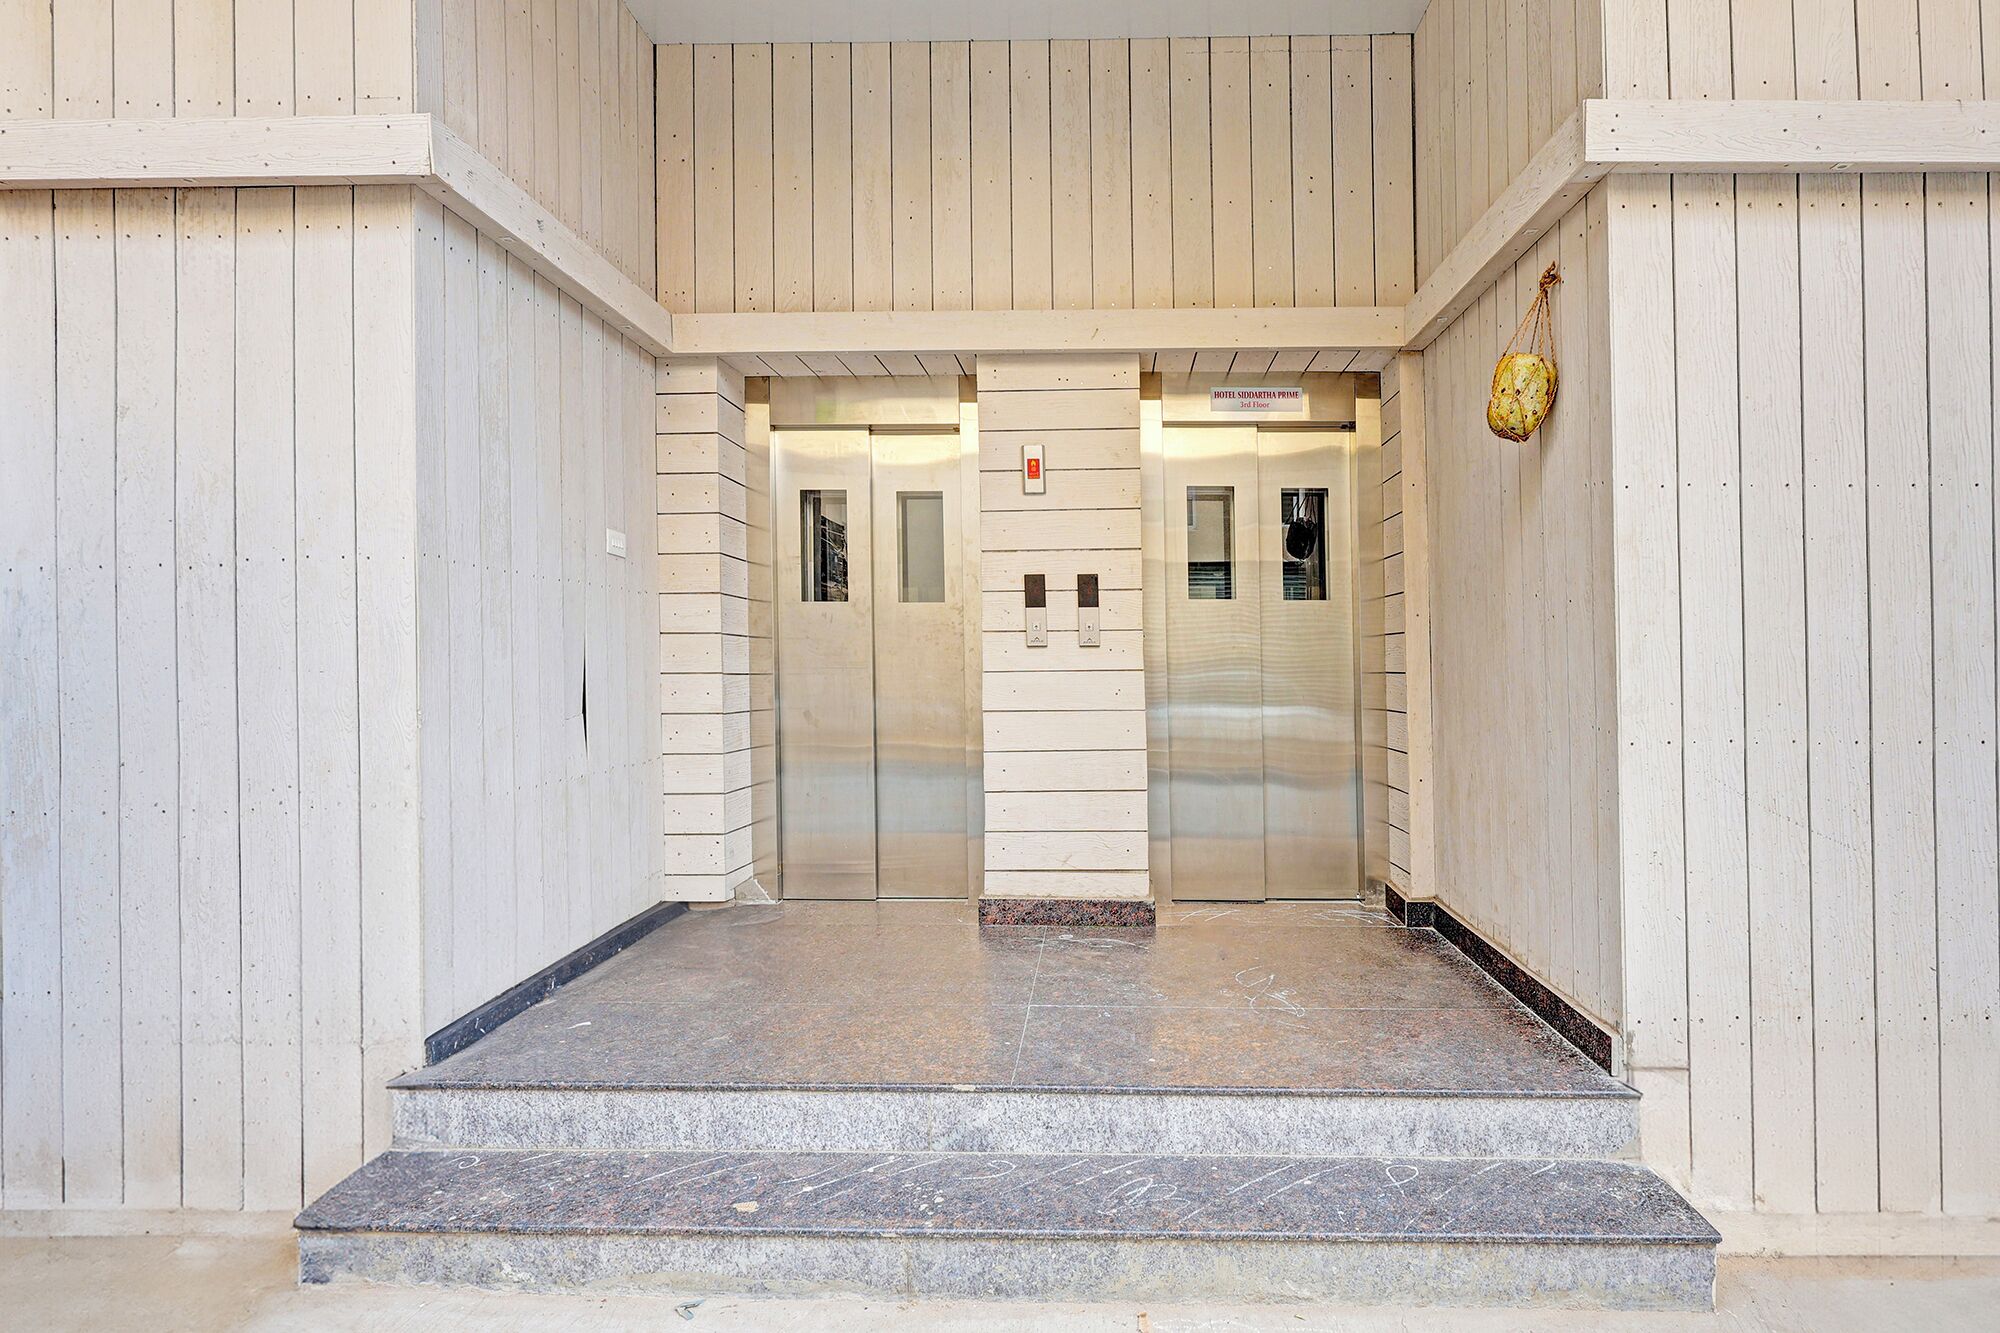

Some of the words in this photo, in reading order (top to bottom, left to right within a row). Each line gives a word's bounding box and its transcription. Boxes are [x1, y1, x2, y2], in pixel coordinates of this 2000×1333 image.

[1214, 391, 1236, 399] HOTEL
[1238, 391, 1277, 399] SIDDARTHA
[1278, 391, 1299, 399] PRIME
